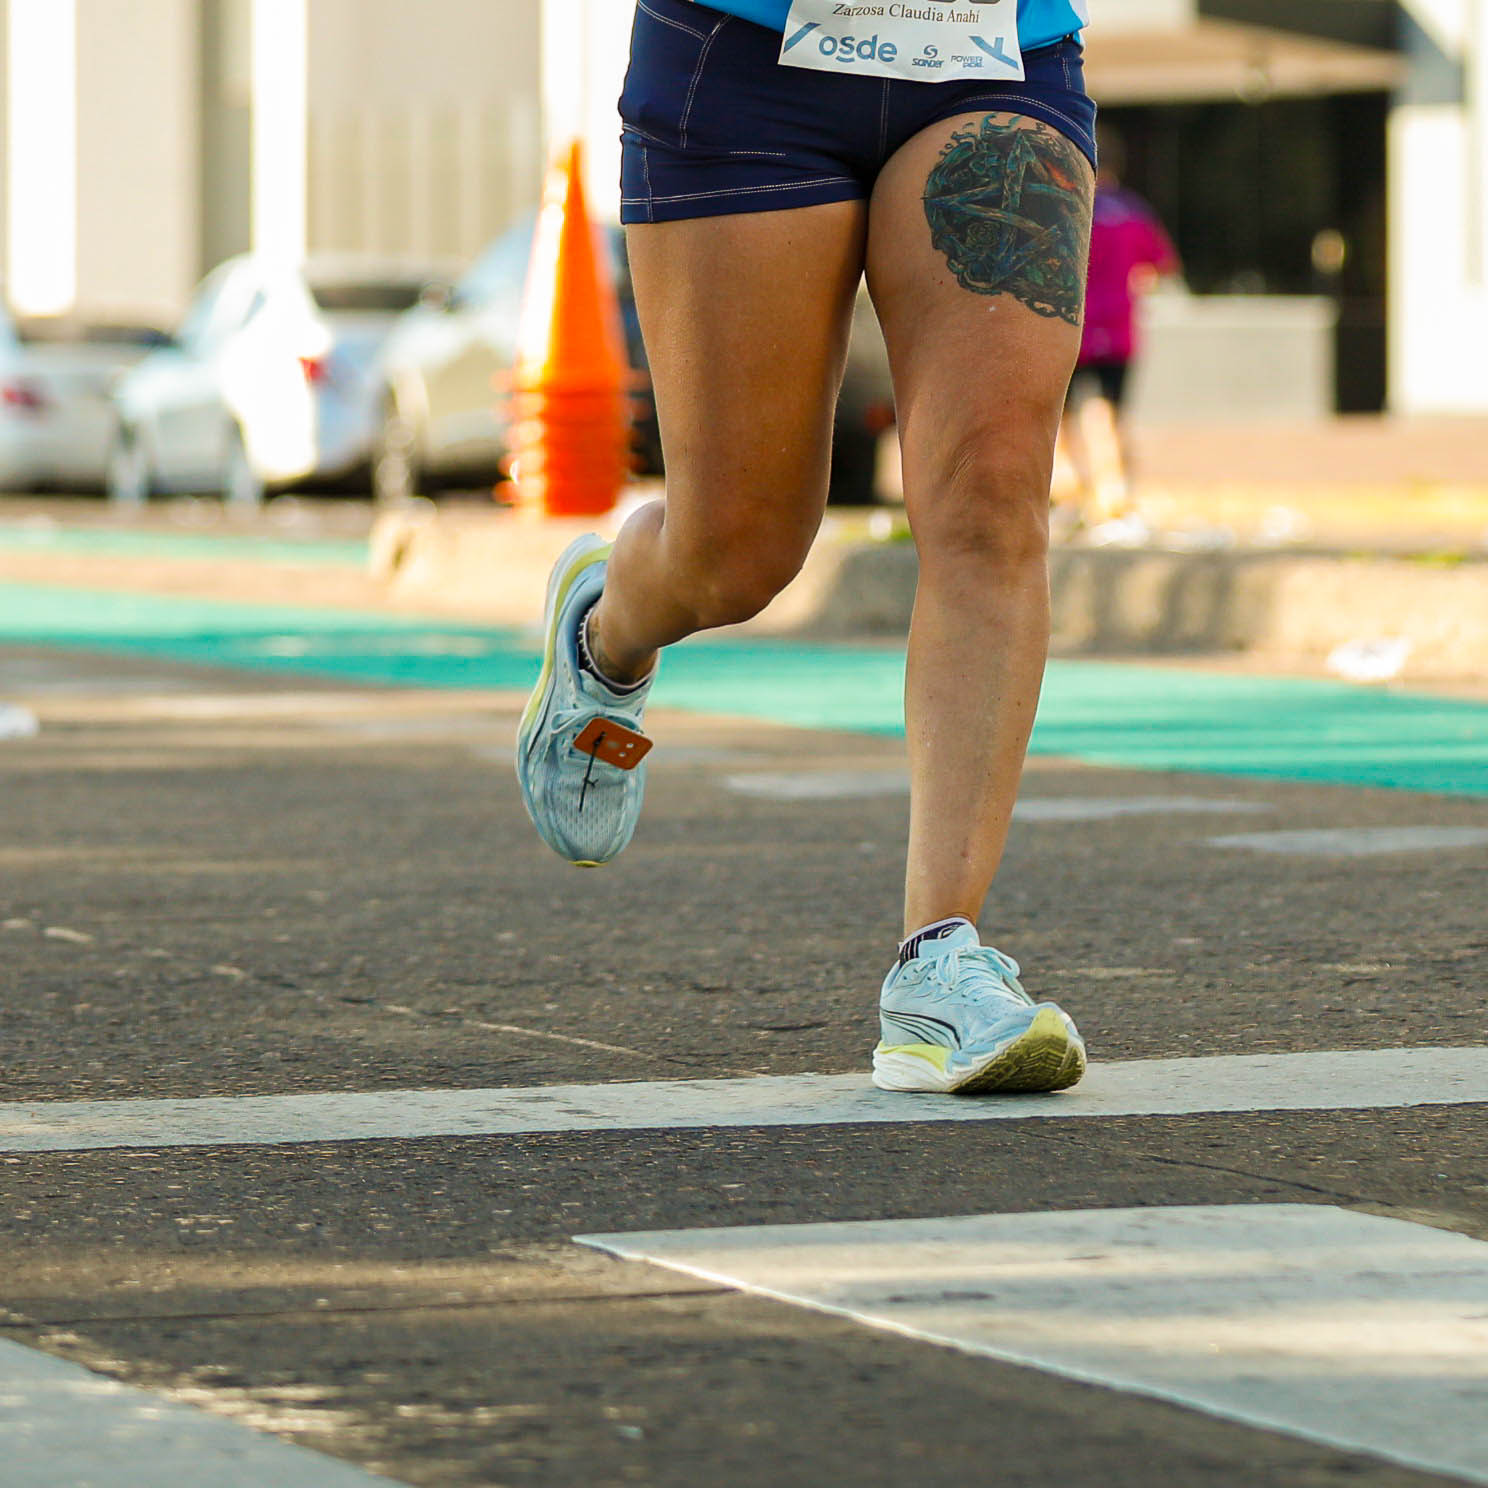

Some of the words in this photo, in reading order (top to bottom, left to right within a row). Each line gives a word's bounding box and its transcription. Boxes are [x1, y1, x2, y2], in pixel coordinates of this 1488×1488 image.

[832, 3, 885, 17] Zarzosa
[889, 3, 944, 22] Claudia
[818, 33, 898, 63] osde
[950, 55, 983, 63] POWER
